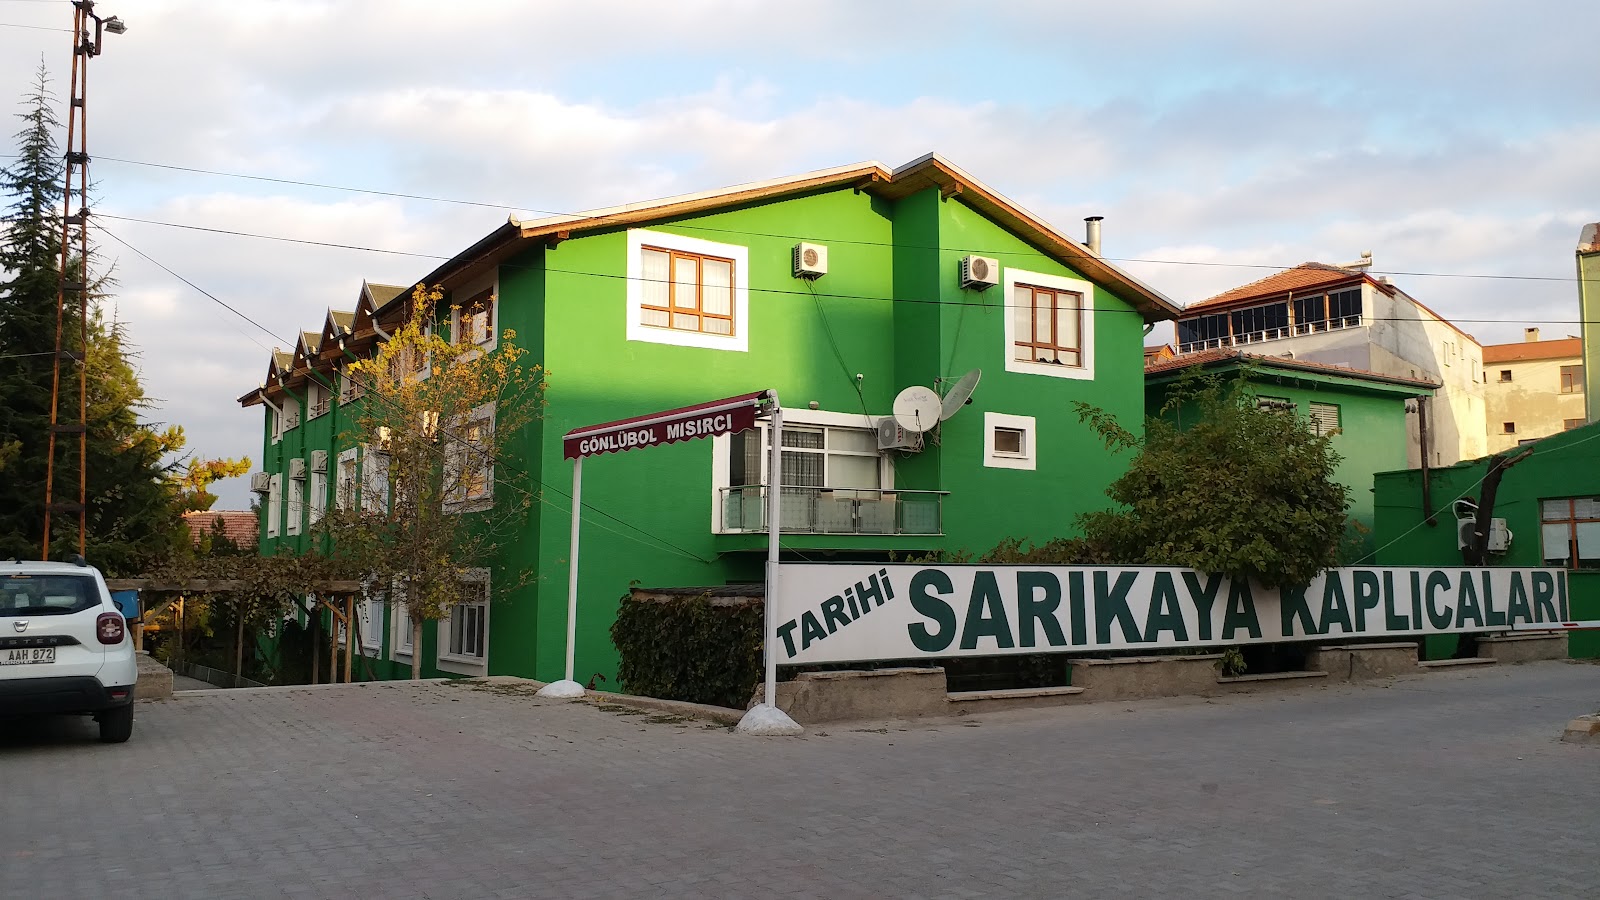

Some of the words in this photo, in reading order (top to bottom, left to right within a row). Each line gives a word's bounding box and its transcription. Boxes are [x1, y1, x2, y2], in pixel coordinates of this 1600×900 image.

[579, 429, 657, 454] GÖNLÜBOL
[667, 414, 732, 440] MISIRCI
[908, 568, 1263, 652] SARIKAYA
[1280, 570, 1567, 637] KAPLICALARI
[8, 649, 29, 661] AAH
[32, 648, 53, 660] 872
